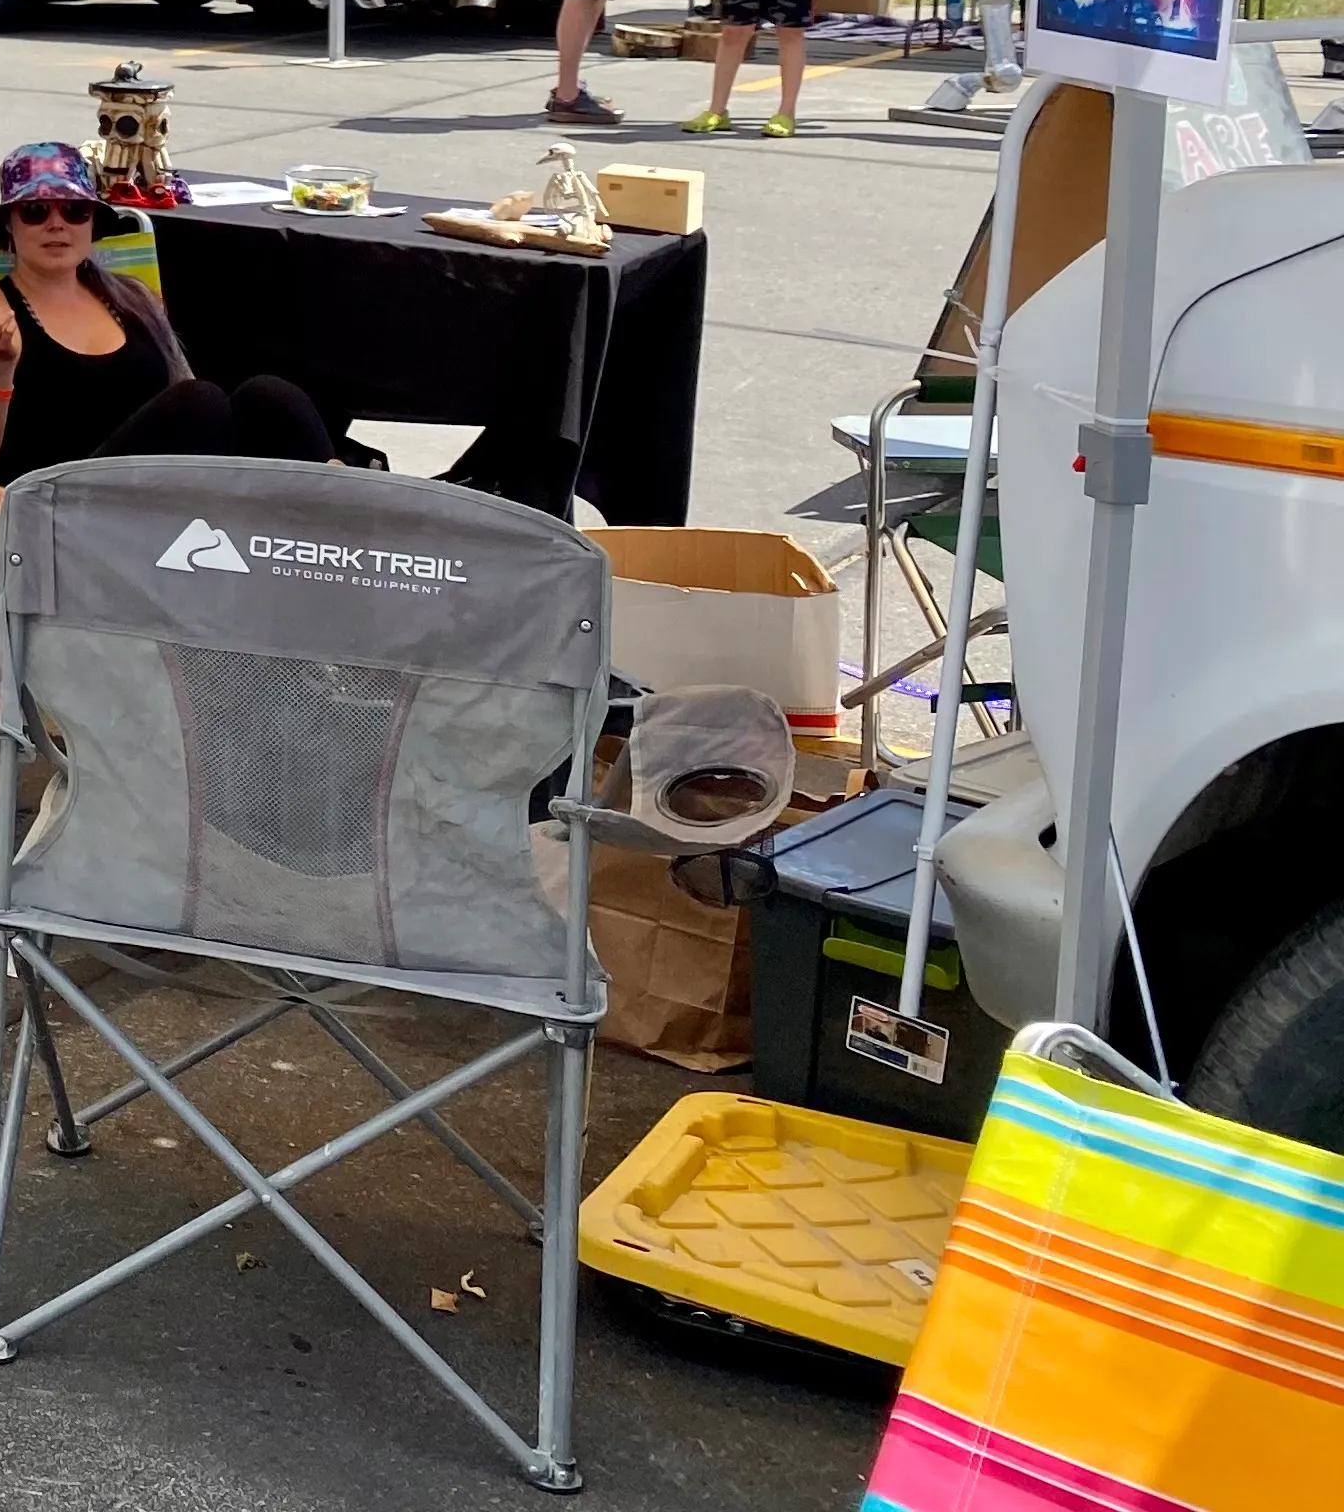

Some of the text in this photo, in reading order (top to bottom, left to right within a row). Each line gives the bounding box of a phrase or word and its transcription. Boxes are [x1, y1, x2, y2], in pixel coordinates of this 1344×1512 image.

[249, 535, 365, 571] OZARK
[272, 566, 442, 595] OUTDOOR EQUIPMENT
